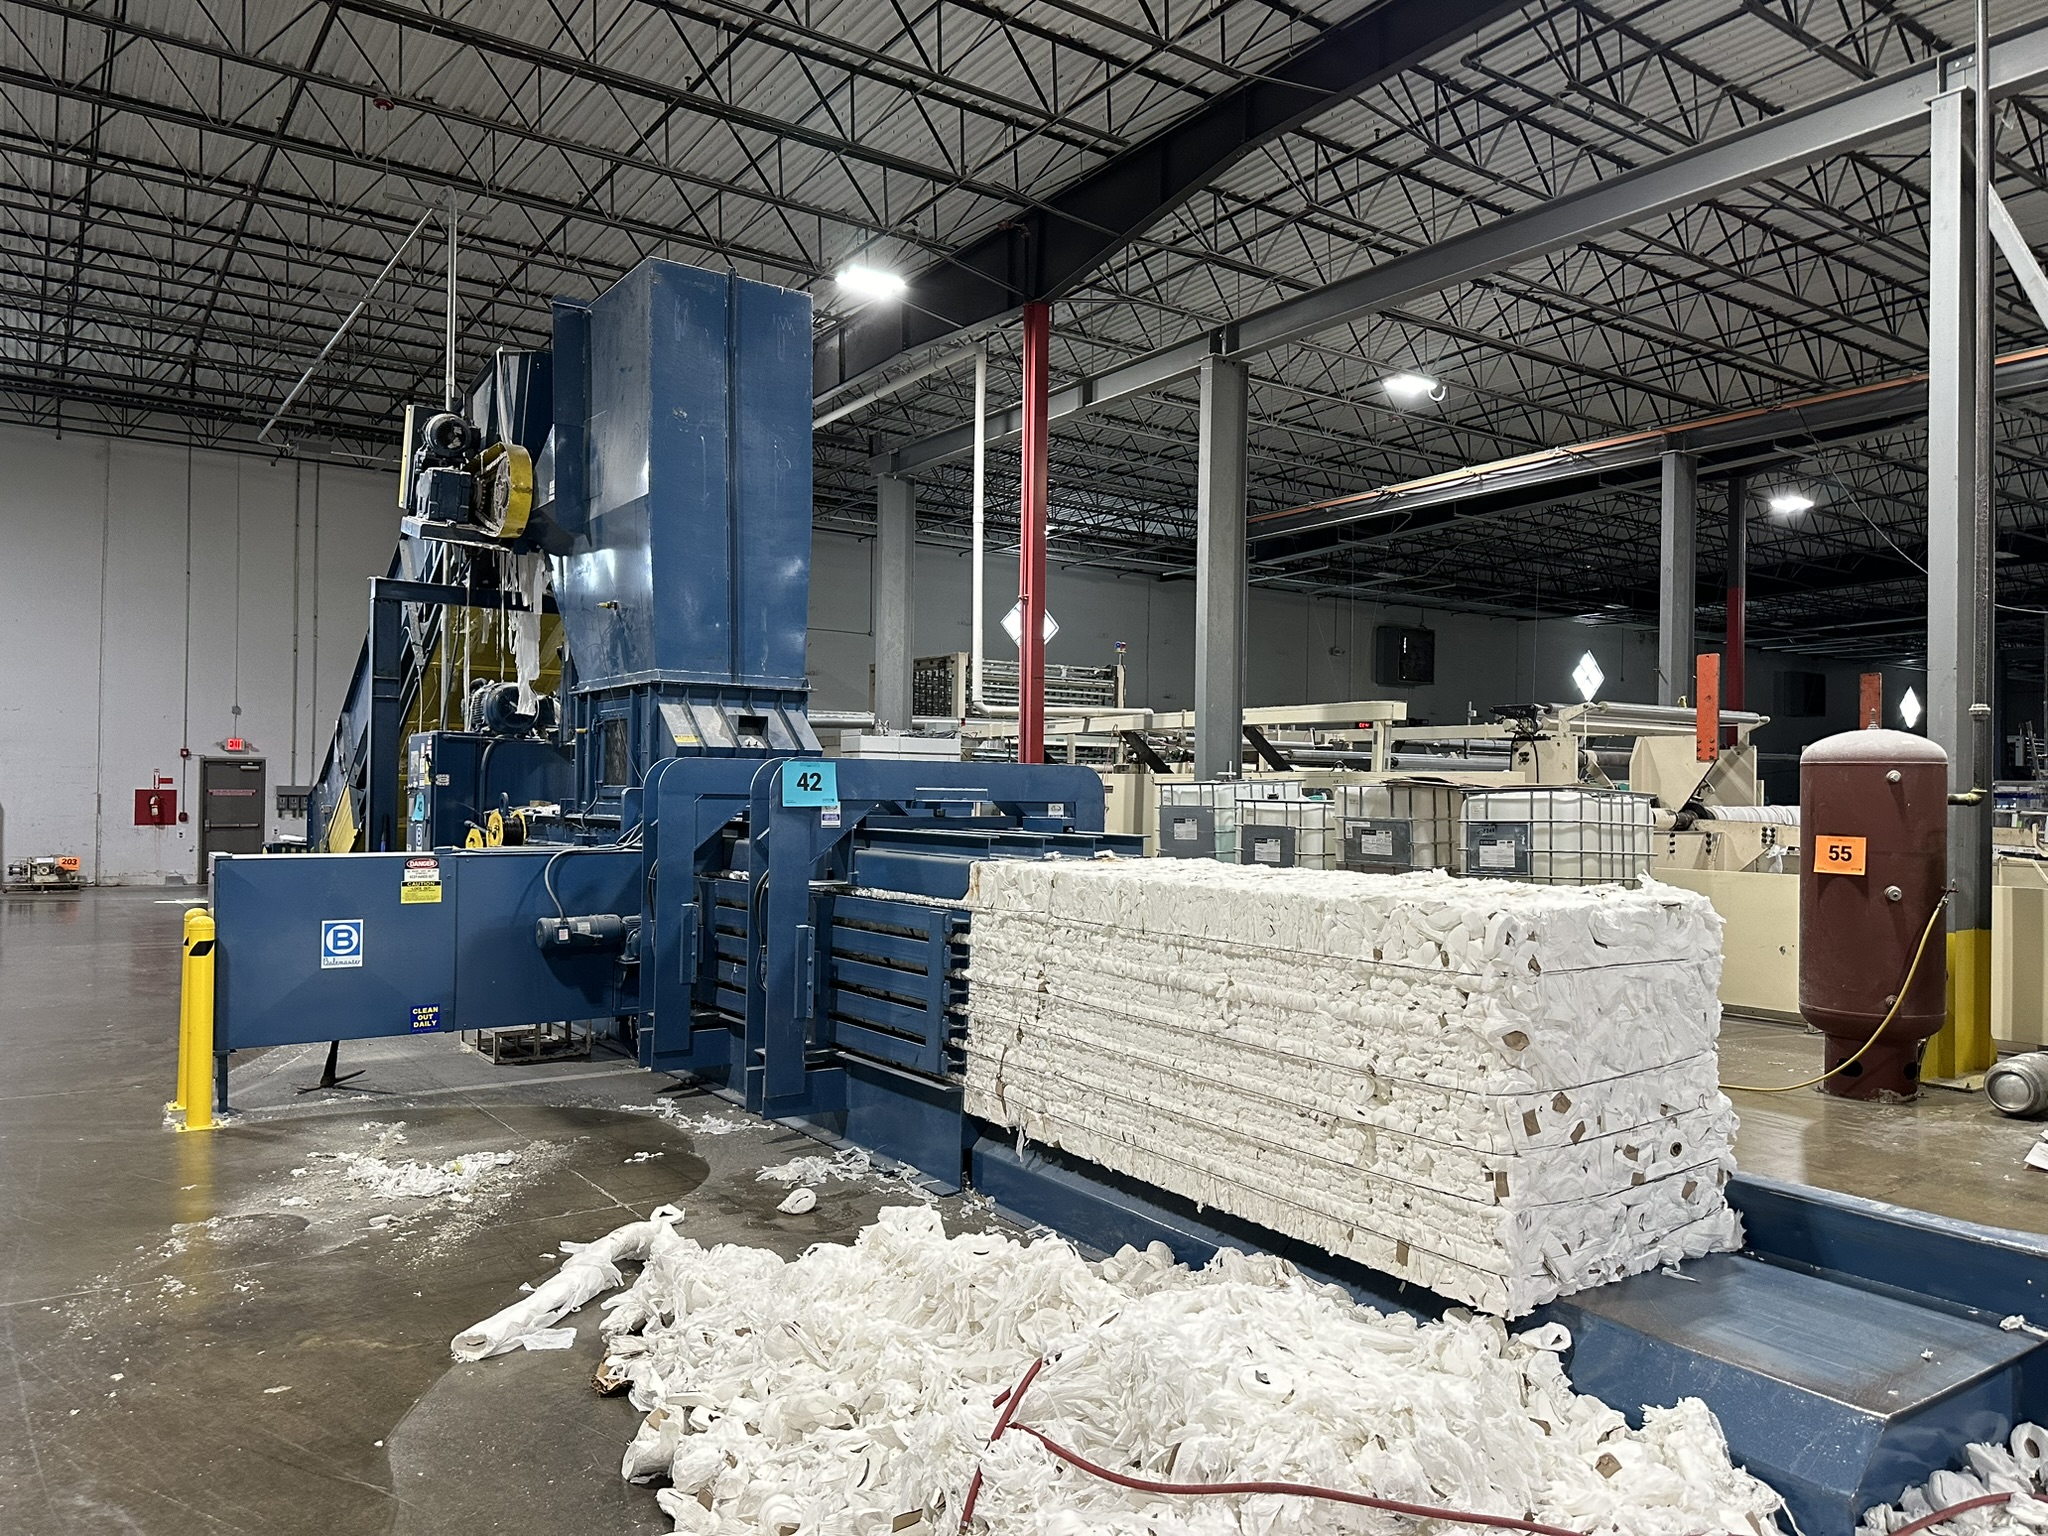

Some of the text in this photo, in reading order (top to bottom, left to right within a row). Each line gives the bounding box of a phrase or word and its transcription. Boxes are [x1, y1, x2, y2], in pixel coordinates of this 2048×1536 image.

[228, 738, 243, 750] EXIT
[797, 772, 822, 791] 42
[1828, 845, 1852, 861] 55
[333, 929, 353, 950] B
[412, 1006, 439, 1014] CLEAN
[413, 1020, 437, 1028] DAILY
